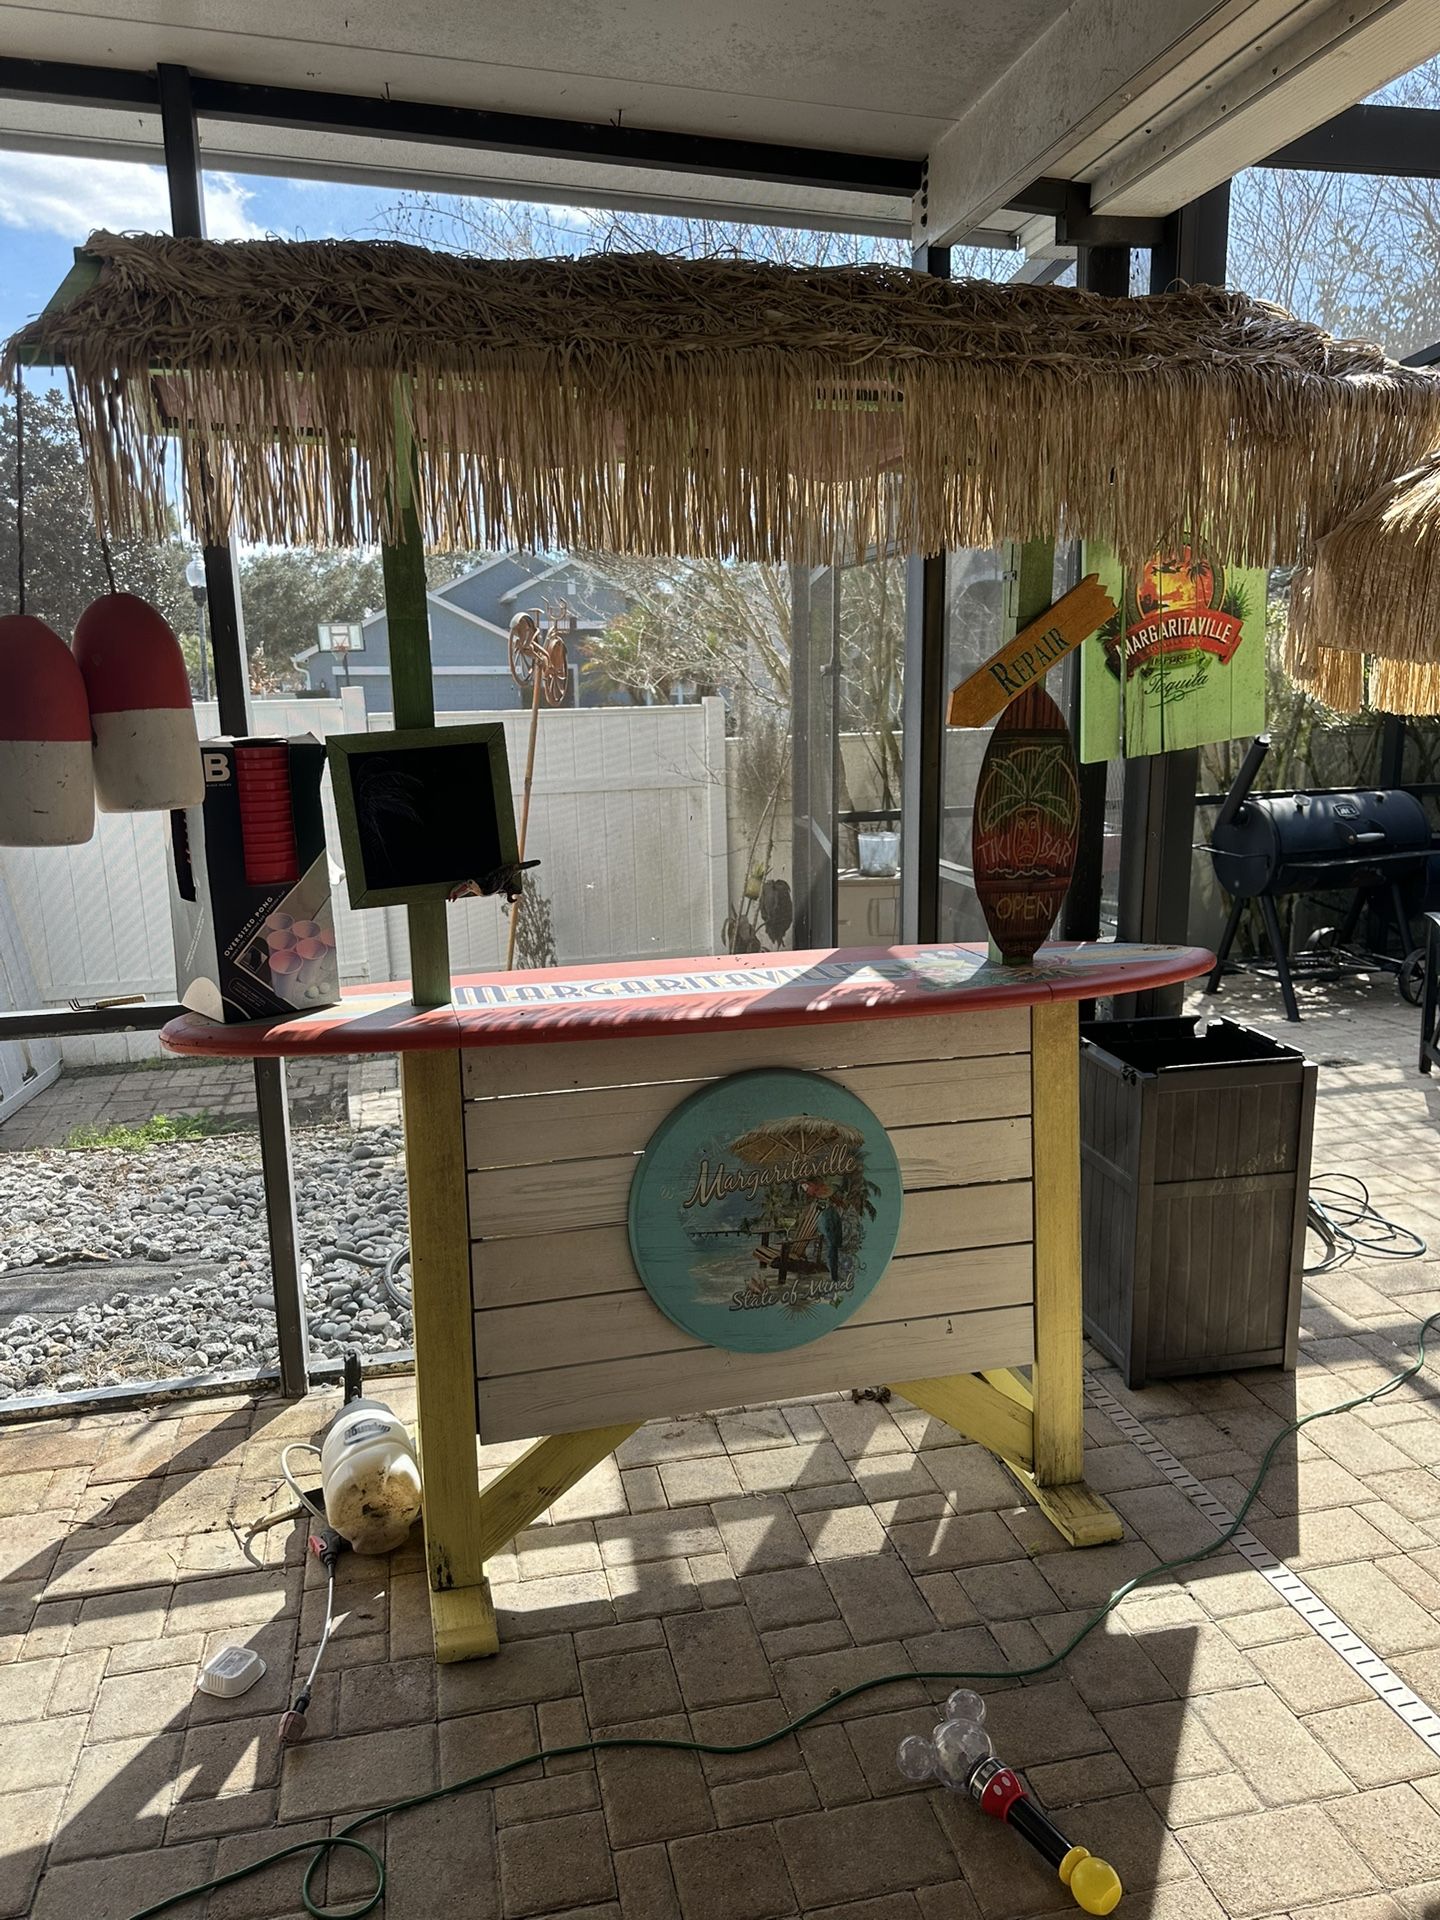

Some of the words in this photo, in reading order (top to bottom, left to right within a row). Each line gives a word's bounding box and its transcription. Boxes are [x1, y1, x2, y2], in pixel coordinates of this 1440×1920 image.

[1115, 616, 1232, 660] MARGARITAVILLE
[1144, 667, 1208, 703] Tequila
[203, 753, 231, 783] B
[977, 833, 1011, 865] TIKI
[1039, 831, 1073, 867] BAR
[224, 918, 255, 957] OVERSIZED
[254, 896, 273, 918] PONG
[996, 896, 1053, 920] OPEN
[453, 961, 866, 1006] MARGARITAVILLE
[683, 1143, 857, 1208] Margaritaville
[729, 1287, 777, 1311] State
[781, 1279, 800, 1306] of
[802, 1272, 855, 1299] Mind
